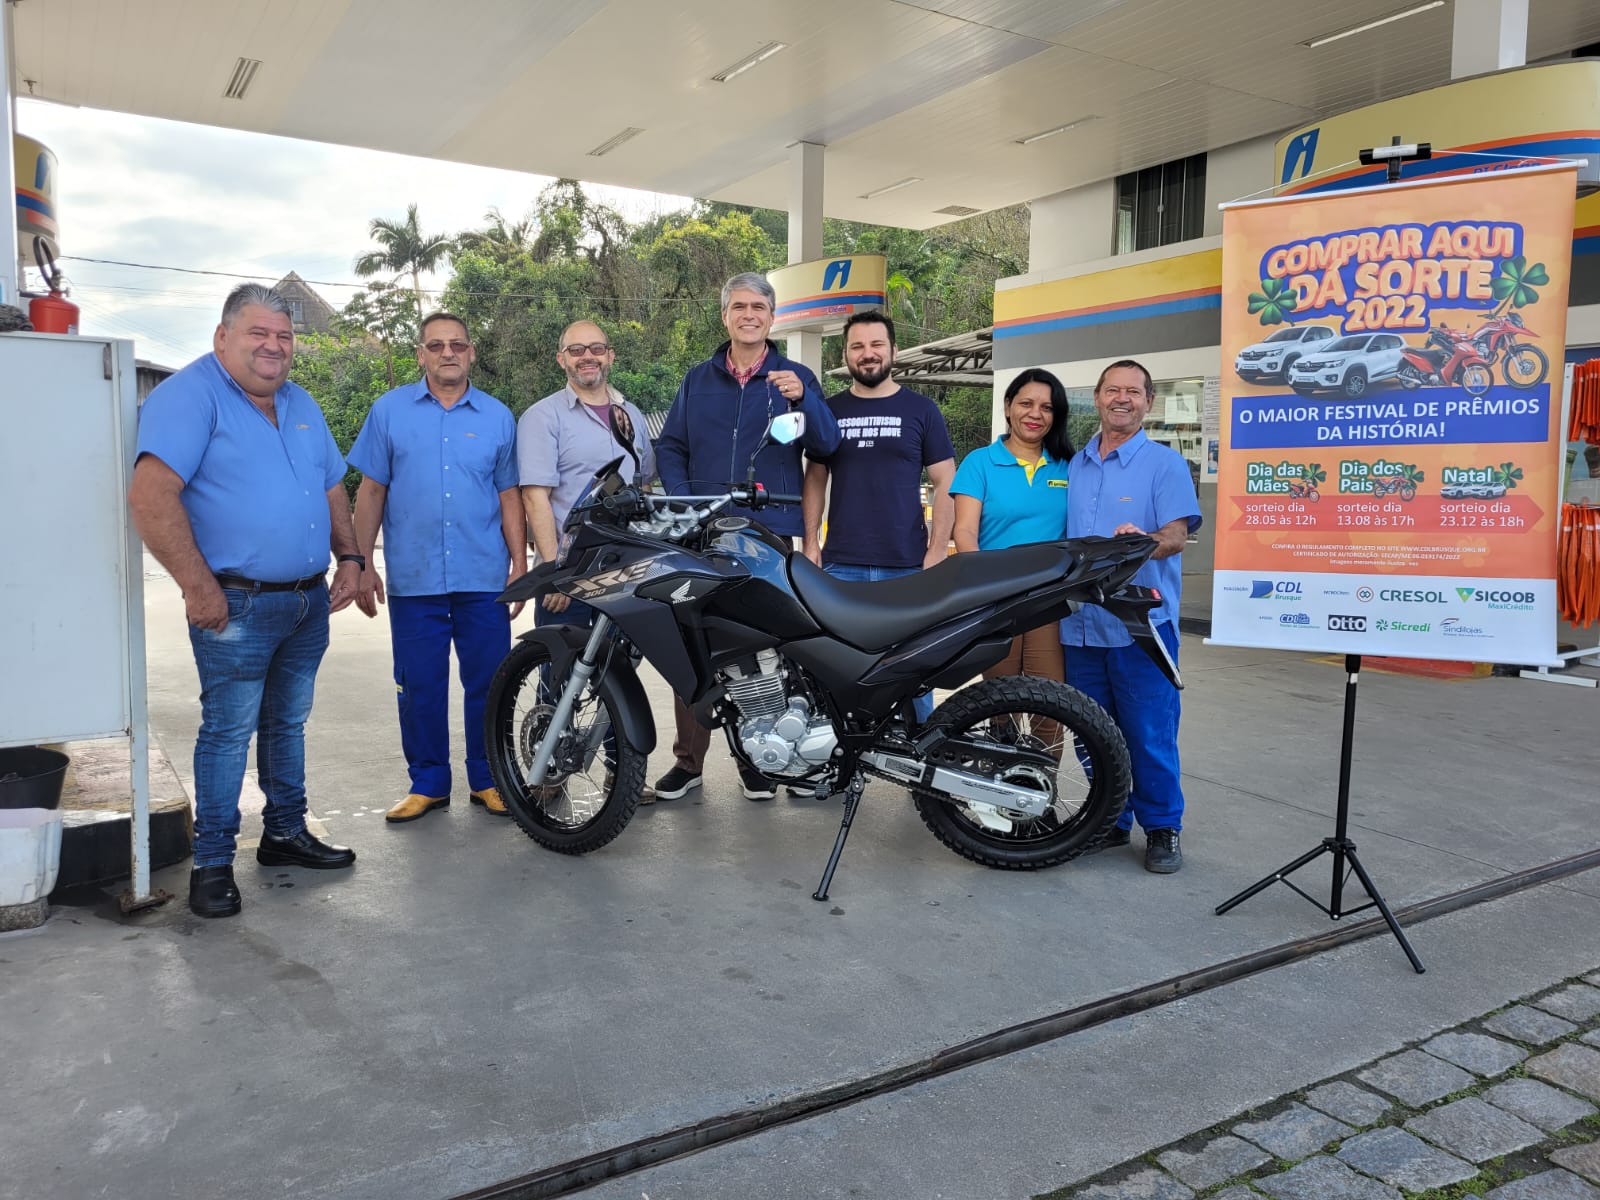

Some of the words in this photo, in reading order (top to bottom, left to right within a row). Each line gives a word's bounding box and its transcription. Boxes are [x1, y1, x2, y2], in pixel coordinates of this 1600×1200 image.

[1267, 228, 1423, 278] COMPRAR
[1427, 226, 1515, 259] AQUI
[1288, 258, 1348, 312] DÁ
[1353, 259, 1494, 300] SORTE
[1345, 295, 1427, 331] 2022
[1239, 409, 1253, 424] O
[1258, 407, 1319, 423] MAIOR
[1324, 403, 1407, 421] FESTIVAL
[1413, 402, 1439, 417] DE
[1445, 397, 1540, 416] PRÊMIOS
[1317, 425, 1342, 440] DA
[1348, 421, 1445, 440] HISTÓRIA!
[1248, 463, 1272, 476] Dia
[1277, 463, 1304, 476] das
[1341, 462, 1368, 475] Dia
[1373, 461, 1403, 475] dos
[1444, 468, 1491, 482] Natal
[1248, 478, 1289, 492] Mães
[1340, 478, 1373, 491] Pais
[1246, 502, 1284, 512] sorteio
[1288, 502, 1304, 512] dia
[1337, 502, 1380, 512] sorteio
[1383, 502, 1402, 512] dia
[1440, 502, 1486, 513] sorteio
[1490, 502, 1511, 513] dia
[1246, 515, 1276, 525] 28.05
[1280, 515, 1291, 525] às
[1295, 515, 1316, 525] 12h
[1337, 515, 1370, 526] 13.08
[1374, 515, 1387, 526] às
[1391, 515, 1415, 526] 17h
[1440, 516, 1476, 527] 23.12
[1480, 515, 1495, 527] às
[1499, 516, 1524, 527] 18h
[1275, 581, 1303, 594] CDL
[1380, 589, 1448, 603] CRESOL
[1475, 590, 1535, 603] SICOOB
[1280, 614, 1298, 624] CDL
[1391, 621, 1431, 632] Sicredi
[1443, 625, 1483, 634] Sindilojas
